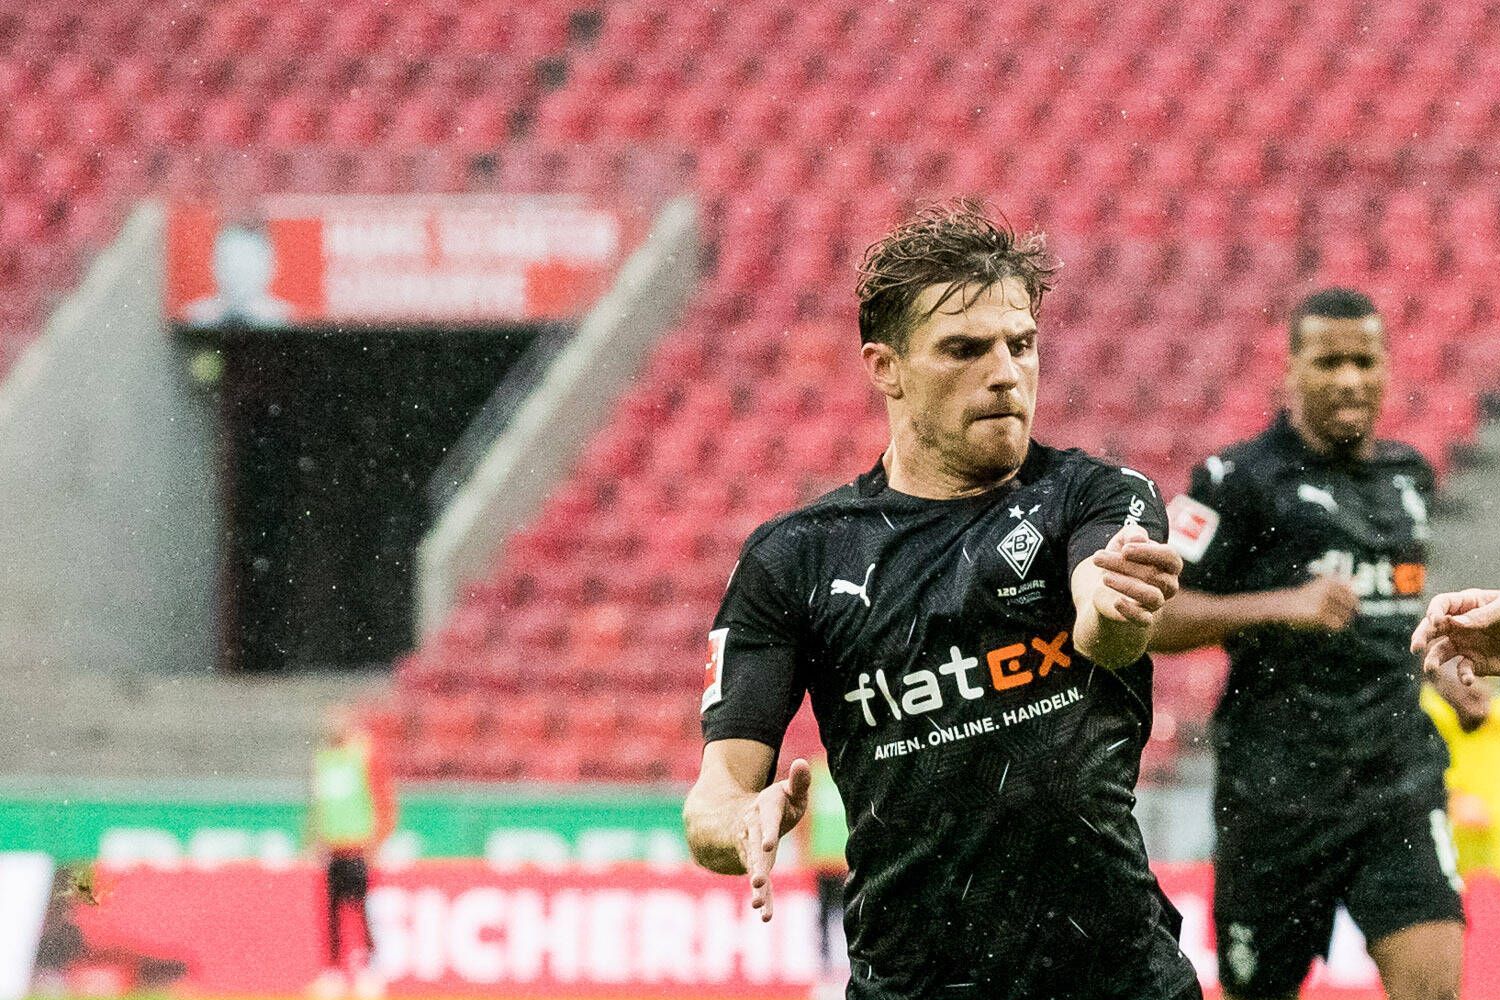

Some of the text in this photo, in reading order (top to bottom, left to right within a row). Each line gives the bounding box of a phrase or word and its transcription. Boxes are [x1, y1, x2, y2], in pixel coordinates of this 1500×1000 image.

[997, 586, 1018, 598] 120
[874, 686, 1085, 761] AKTIEN. ONLINE. HANDELN.
